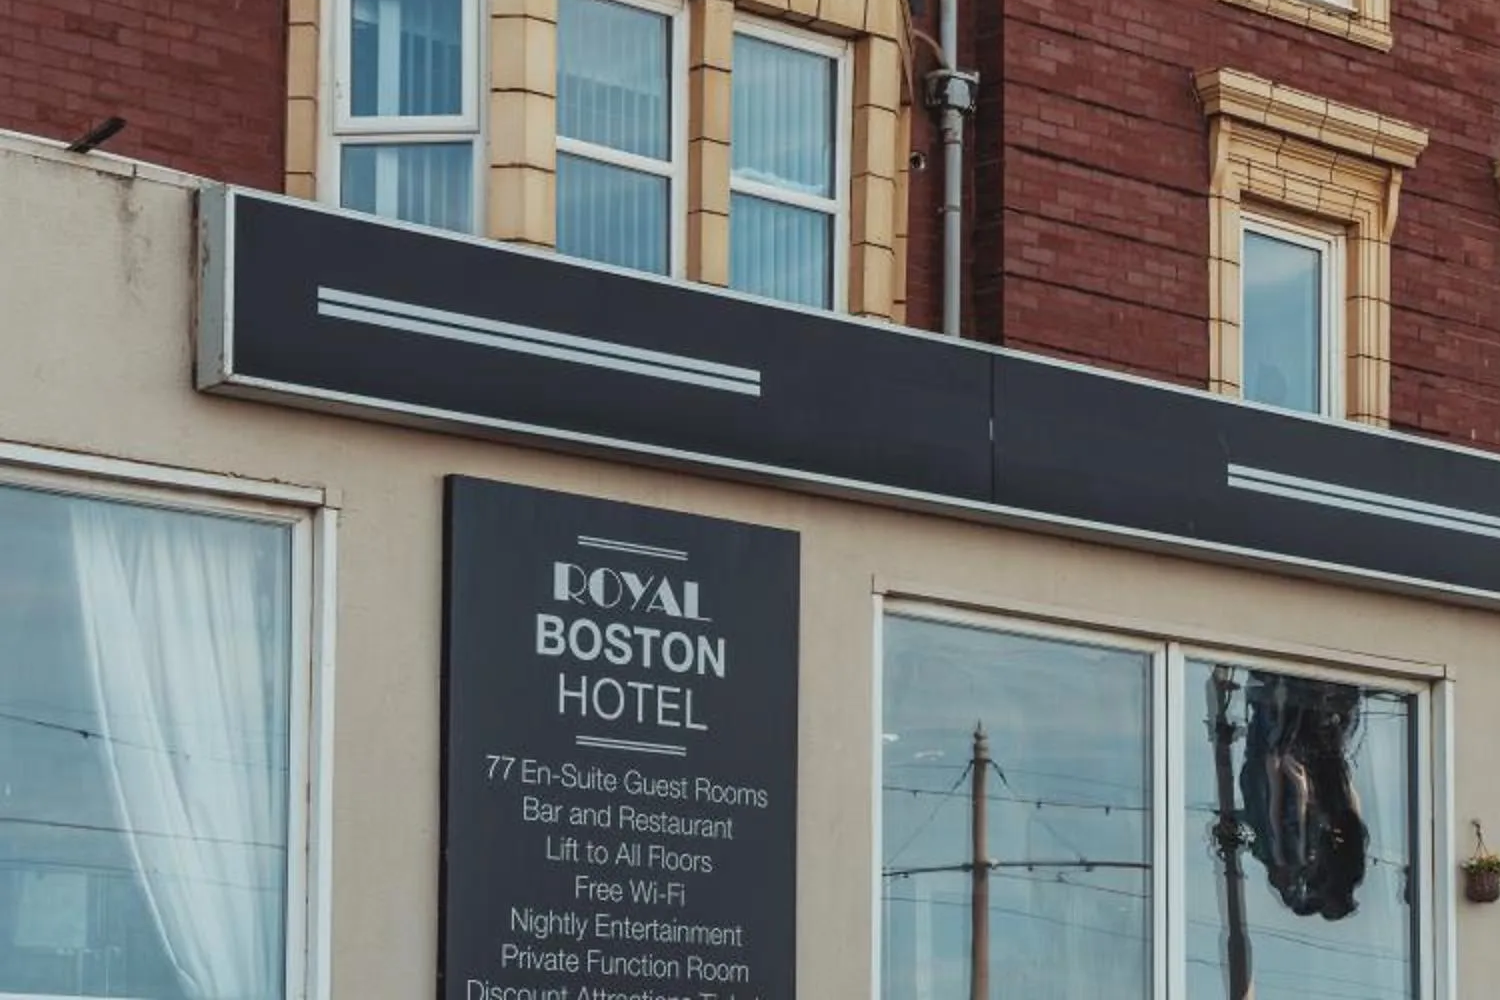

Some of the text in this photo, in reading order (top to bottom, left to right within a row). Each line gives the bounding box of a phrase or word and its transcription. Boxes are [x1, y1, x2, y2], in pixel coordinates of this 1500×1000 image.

[554, 562, 711, 622] ROYAL
[536, 613, 725, 678] BOSTON
[559, 673, 708, 730] HOTEL
[486, 754, 768, 808] 77 En-Suite Guest Rooms
[523, 796, 732, 840] Bar and Restaurant
[546, 836, 712, 872] Lift to All Floors
[576, 875, 685, 906] Free Wi-Fi
[511, 907, 742, 947] Nightly Entertainment
[502, 944, 749, 982] Private Function Room
